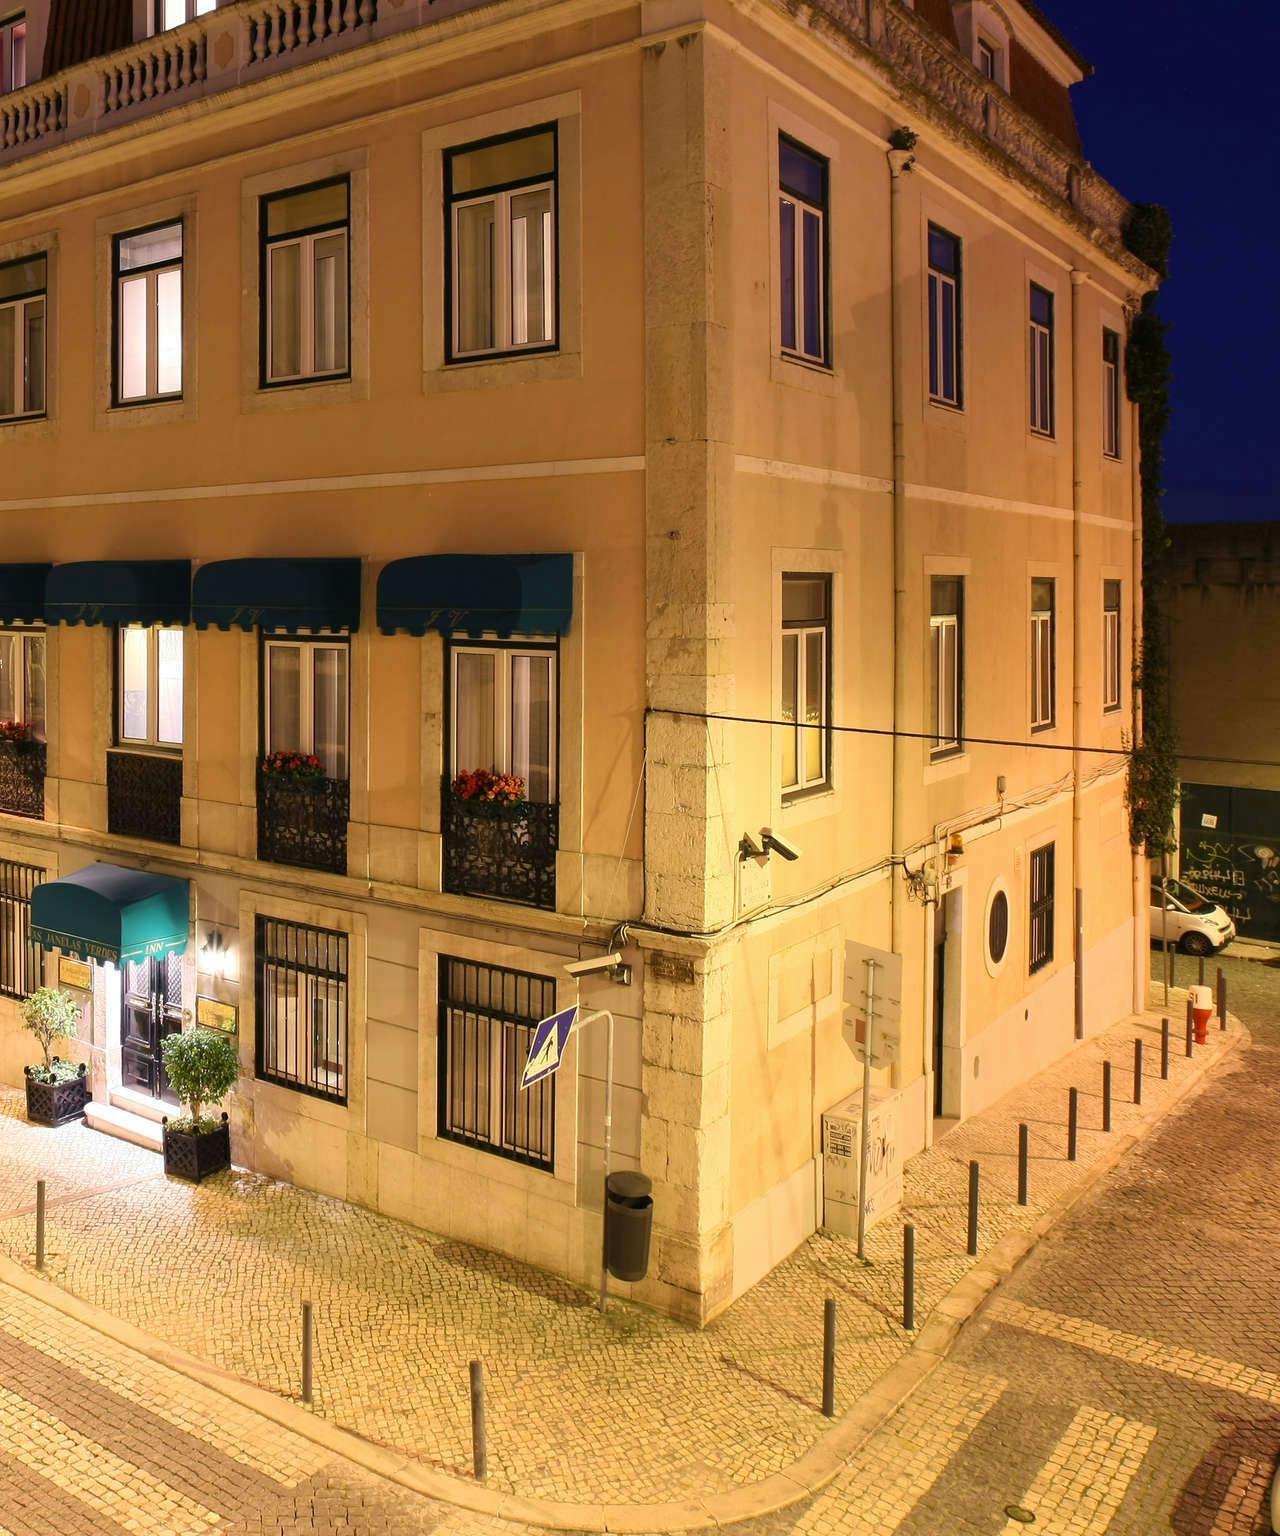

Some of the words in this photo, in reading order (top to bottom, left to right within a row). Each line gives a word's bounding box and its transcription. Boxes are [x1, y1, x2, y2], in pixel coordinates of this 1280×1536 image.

[47, 933, 81, 950] JANELAS
[85, 943, 118, 961] VERDES
[145, 942, 164, 954] INN
